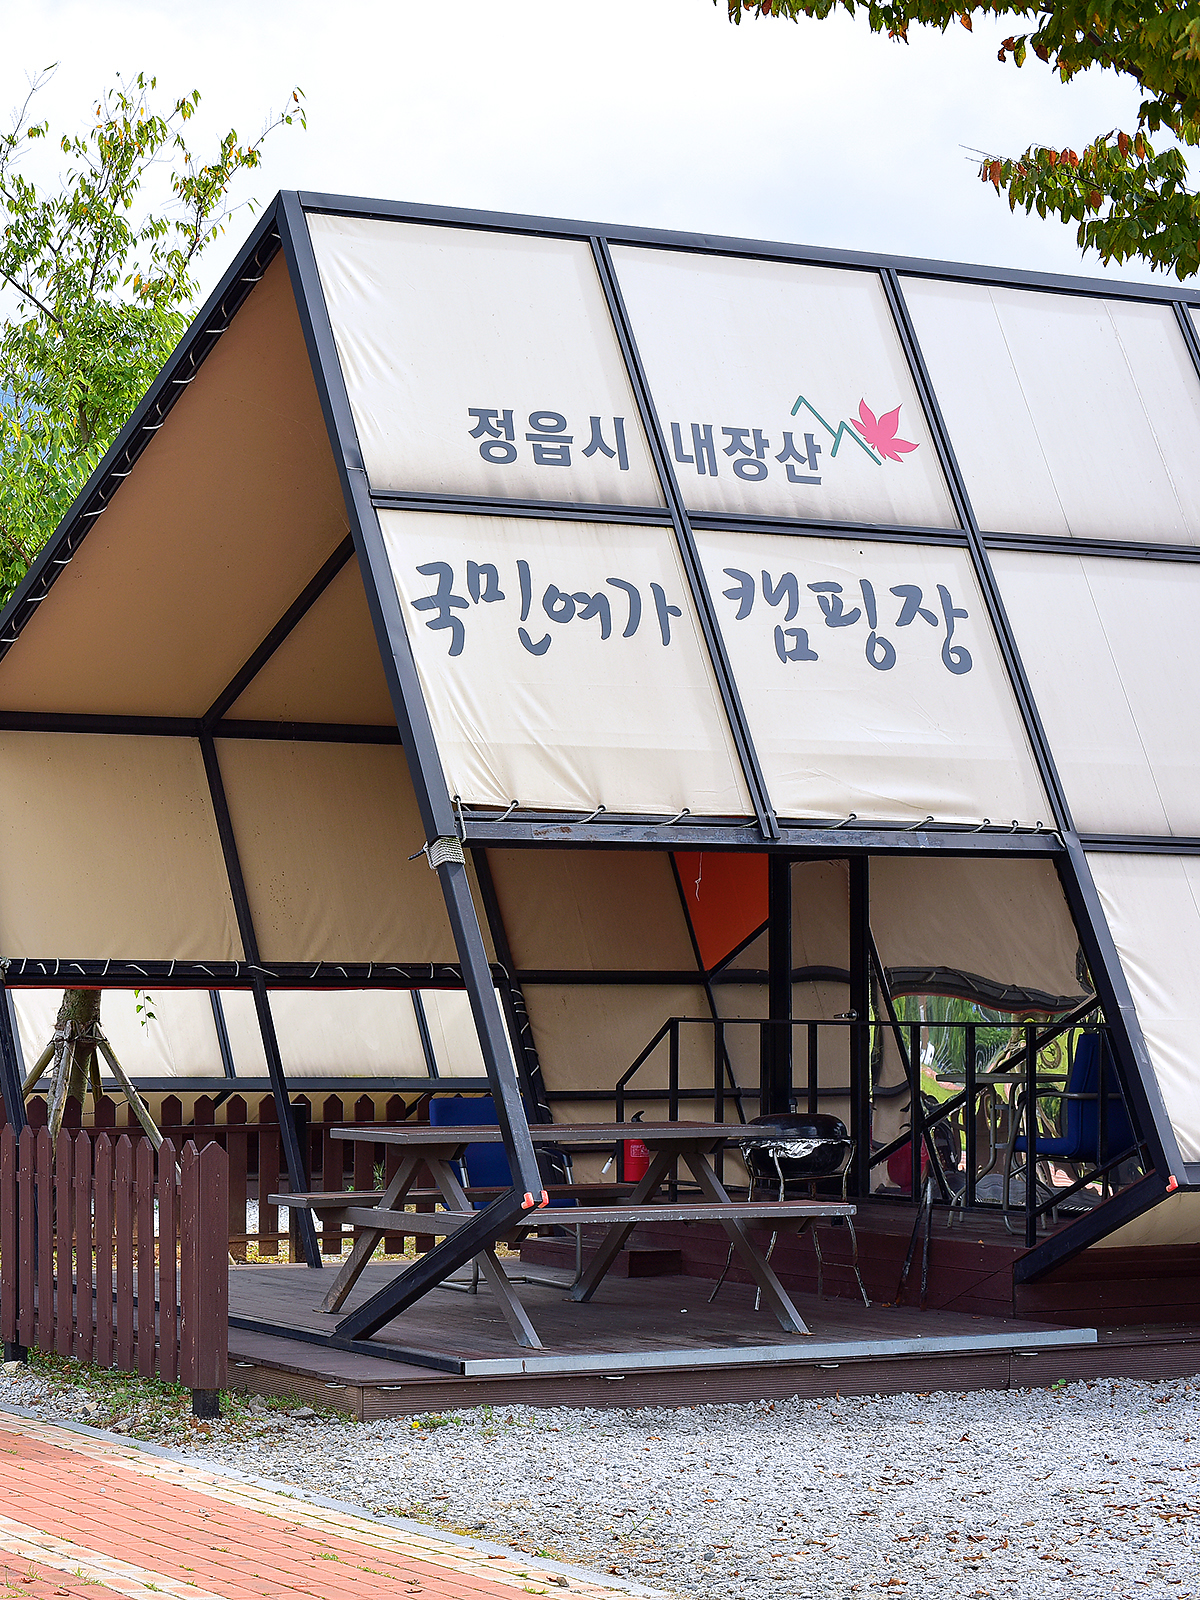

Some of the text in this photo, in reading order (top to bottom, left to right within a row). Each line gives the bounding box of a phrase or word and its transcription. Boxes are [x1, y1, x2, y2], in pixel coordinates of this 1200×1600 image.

[467, 407, 823, 486] 정읍시 내장산
[411, 559, 974, 675] 국민여가 캠핑장
